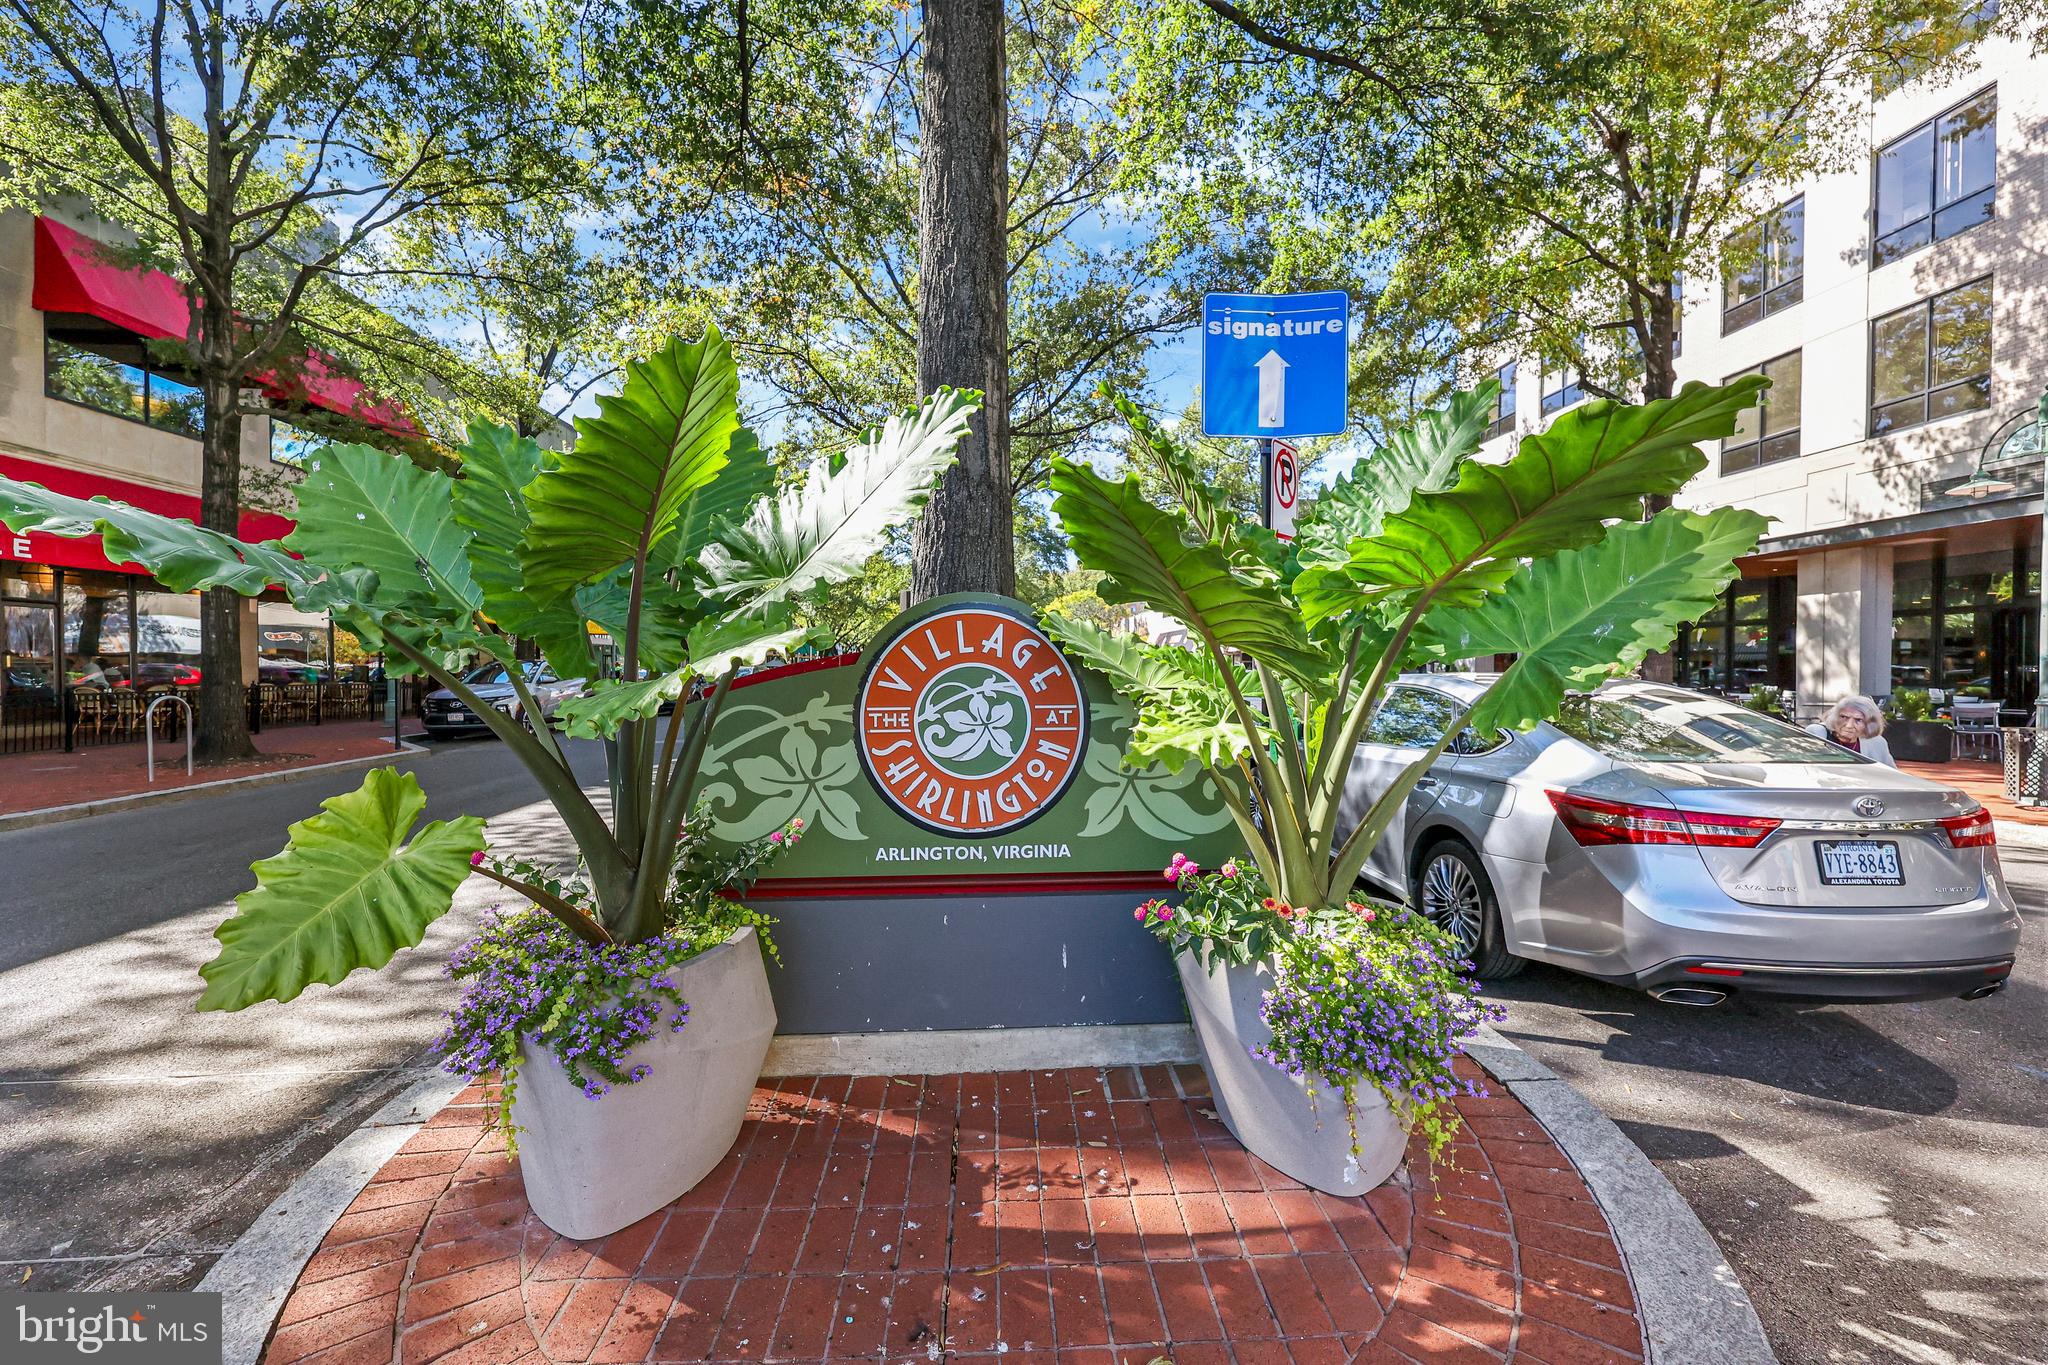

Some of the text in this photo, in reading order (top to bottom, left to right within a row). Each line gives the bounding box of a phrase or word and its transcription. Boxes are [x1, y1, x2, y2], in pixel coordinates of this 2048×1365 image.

[1208, 316, 1344, 340] signature
[0, 537, 33, 559] E
[868, 620, 1073, 824] THE VILLAGE AT SHIRLINGTON
[875, 844, 1072, 863] ARLINGTON, VIRGINIA
[1824, 853, 1897, 874] VYE-8843
